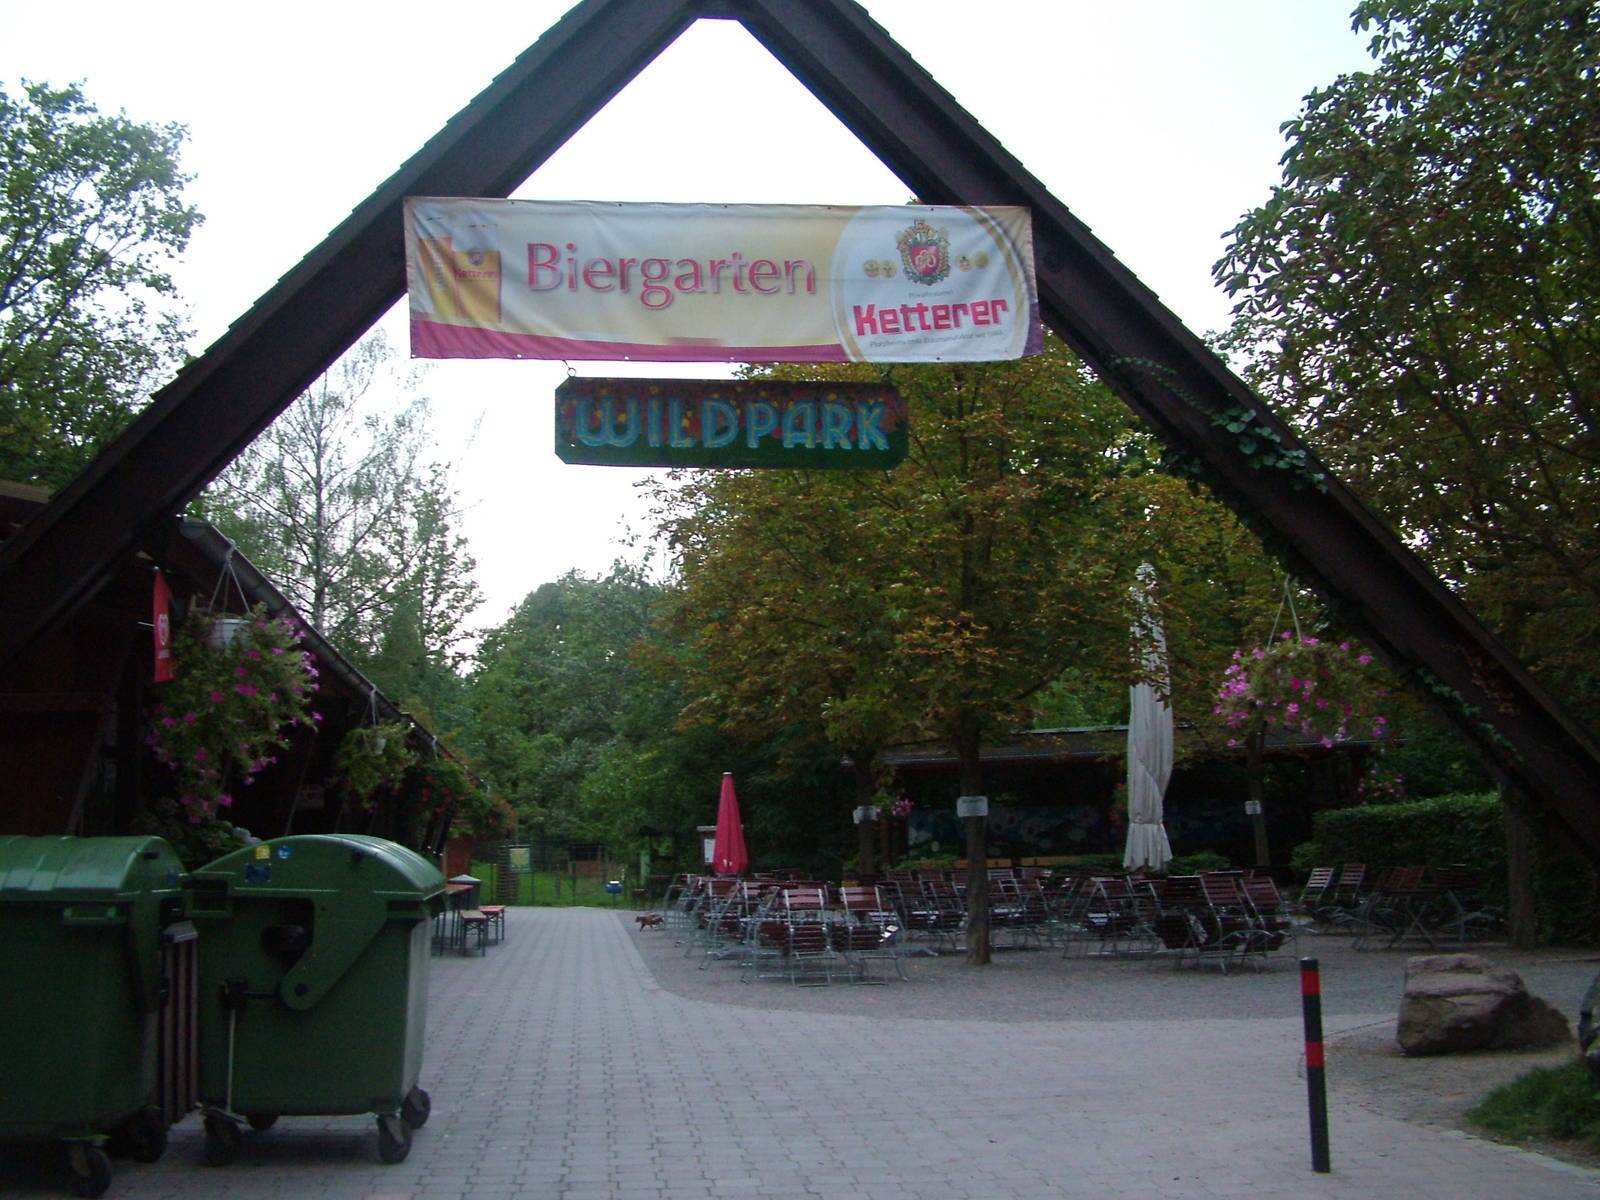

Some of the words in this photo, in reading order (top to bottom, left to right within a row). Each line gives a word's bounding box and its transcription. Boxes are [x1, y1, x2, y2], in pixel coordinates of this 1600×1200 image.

[527, 242, 816, 309] Biergarten
[853, 299, 1008, 336] Ketterer
[575, 397, 890, 451] WILDPARK
